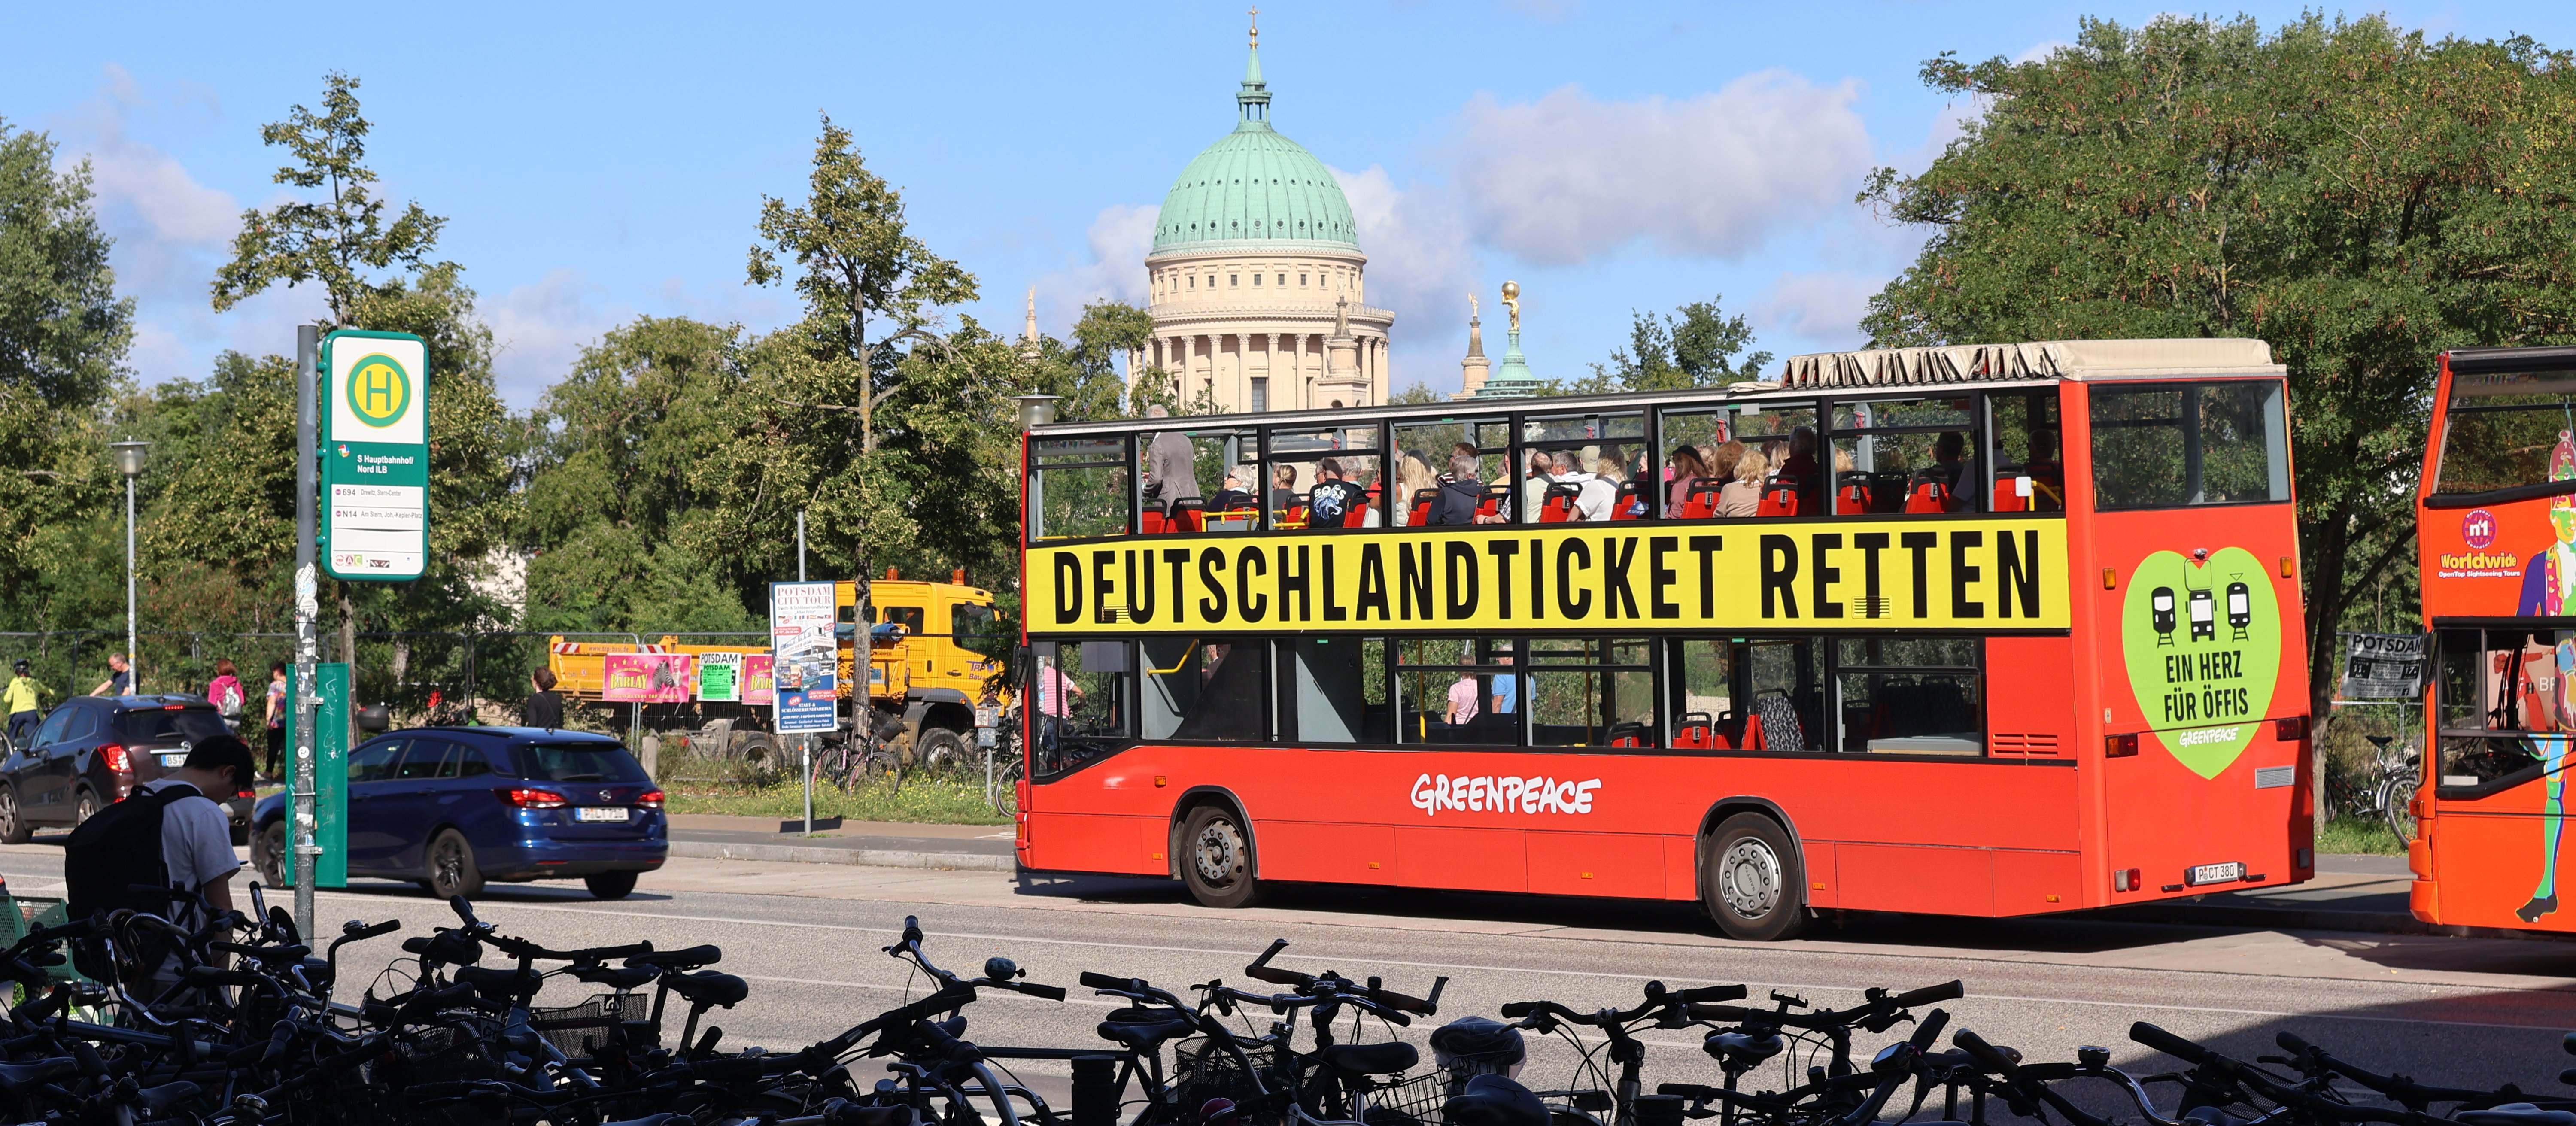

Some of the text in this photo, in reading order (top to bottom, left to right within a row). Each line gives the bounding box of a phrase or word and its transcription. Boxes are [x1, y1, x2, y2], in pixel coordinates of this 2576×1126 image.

[366, 370, 391, 411] H
[364, 455, 414, 464] Hauptbahnhof/
[357, 465, 374, 473] Nord
[1315, 484, 1347, 500] BOSS
[2441, 552, 2517, 569] Worldwide
[1054, 530, 2040, 624] DEUTSCHLANDTICKET RETTEN
[778, 586, 831, 597] POTSDAM
[778, 596, 831, 606] CITY TOUR
[701, 653, 738, 663] POTSDAM
[2166, 650, 2242, 683] EIN HERZ
[610, 673, 648, 690] BARLAY
[2164, 684, 2248, 722] FÜR ÖFFIS
[2179, 727, 2239, 748] GREENPEACE
[1411, 773, 1602, 816] GREENPEACE
[2199, 865, 2234, 880] P CT 380
[1275, 1075, 1292, 1086] BASIL
